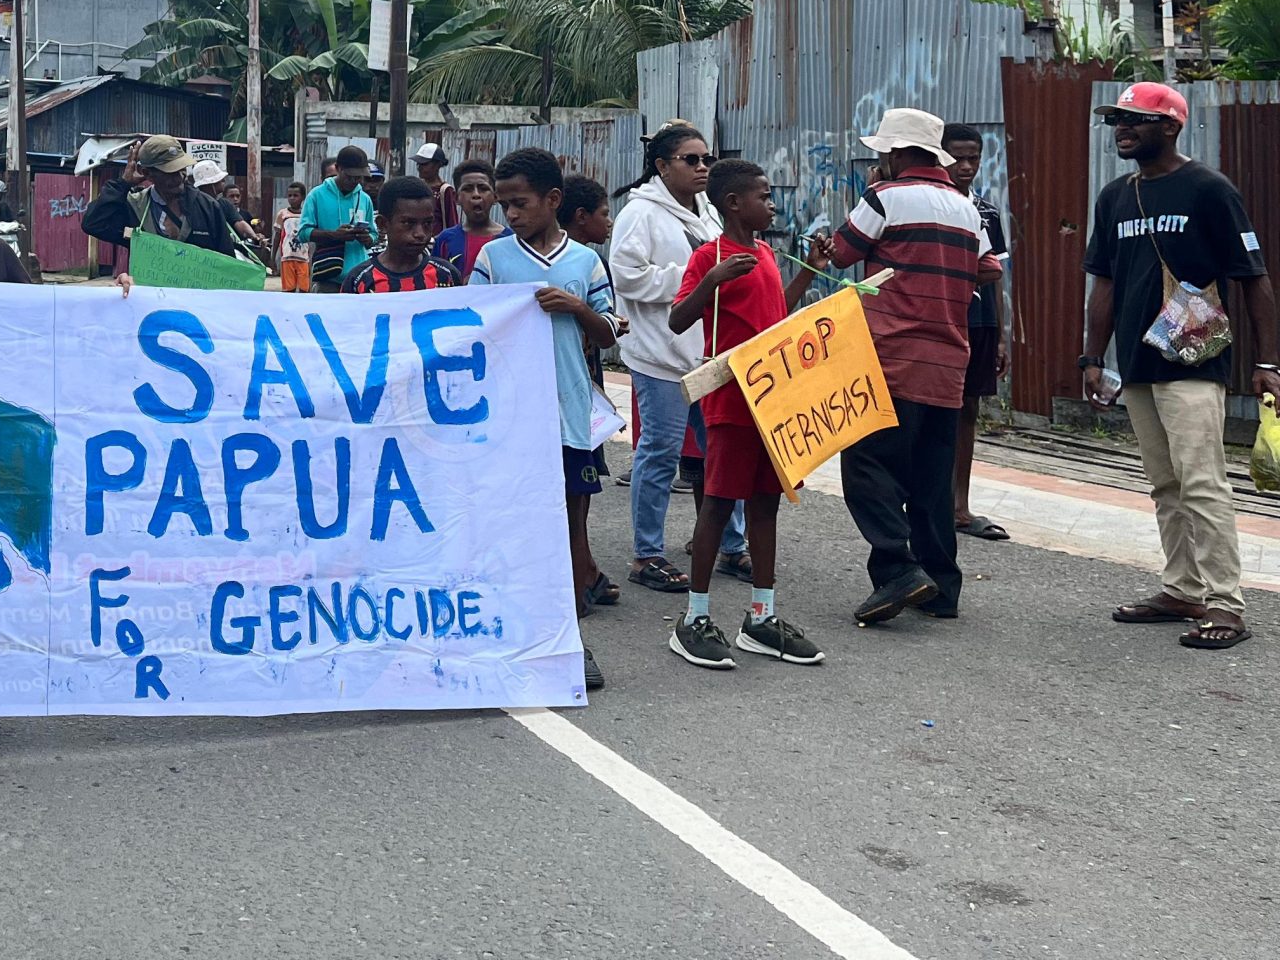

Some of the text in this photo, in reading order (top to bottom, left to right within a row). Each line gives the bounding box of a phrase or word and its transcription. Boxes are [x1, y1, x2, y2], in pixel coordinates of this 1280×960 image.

[1157, 214, 1189, 232] CITY
[133, 306, 489, 425] SAVE
[746, 317, 836, 407] STOP
[85, 430, 436, 540] PAPUA
